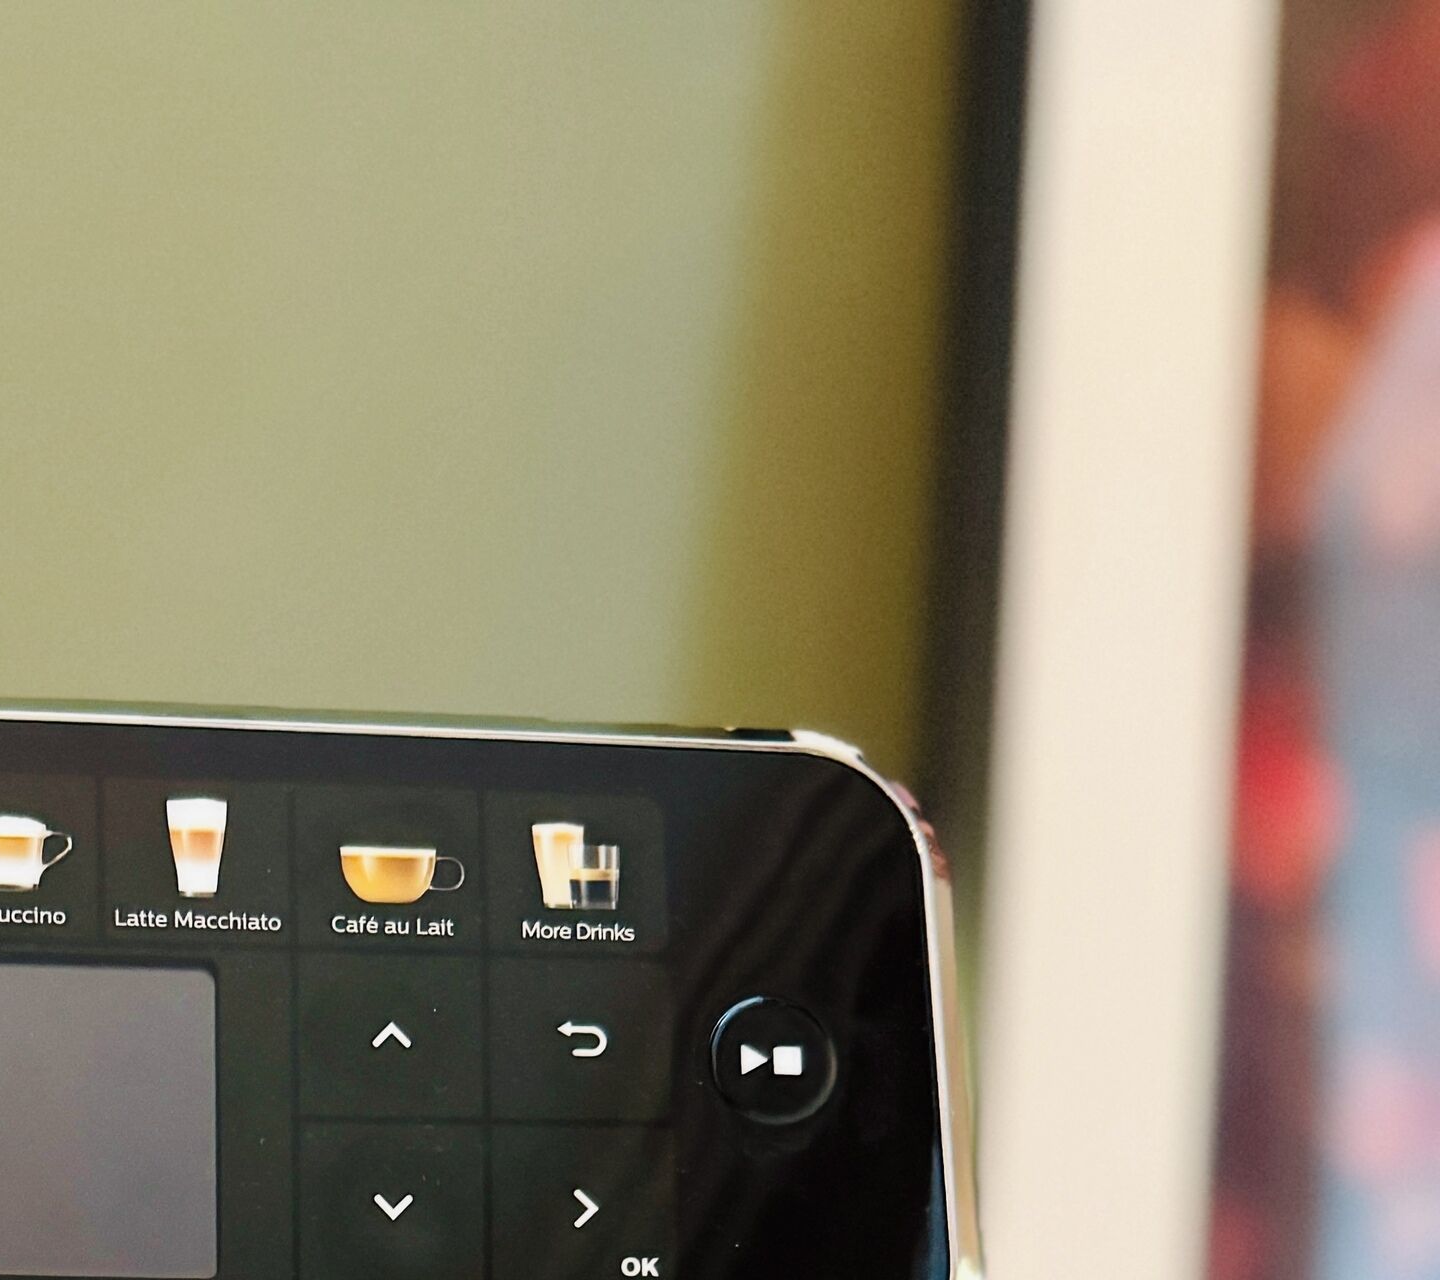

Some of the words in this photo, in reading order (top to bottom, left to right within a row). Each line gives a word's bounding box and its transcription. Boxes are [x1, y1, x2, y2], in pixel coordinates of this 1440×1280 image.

[114, 907, 168, 928] Latte
[173, 909, 282, 931] Macchiato
[331, 914, 379, 934] Café
[384, 920, 410, 935] au
[416, 917, 455, 937] Lait
[521, 920, 572, 940] More
[576, 922, 636, 942] Drinks
[620, 1256, 660, 1278] OK
